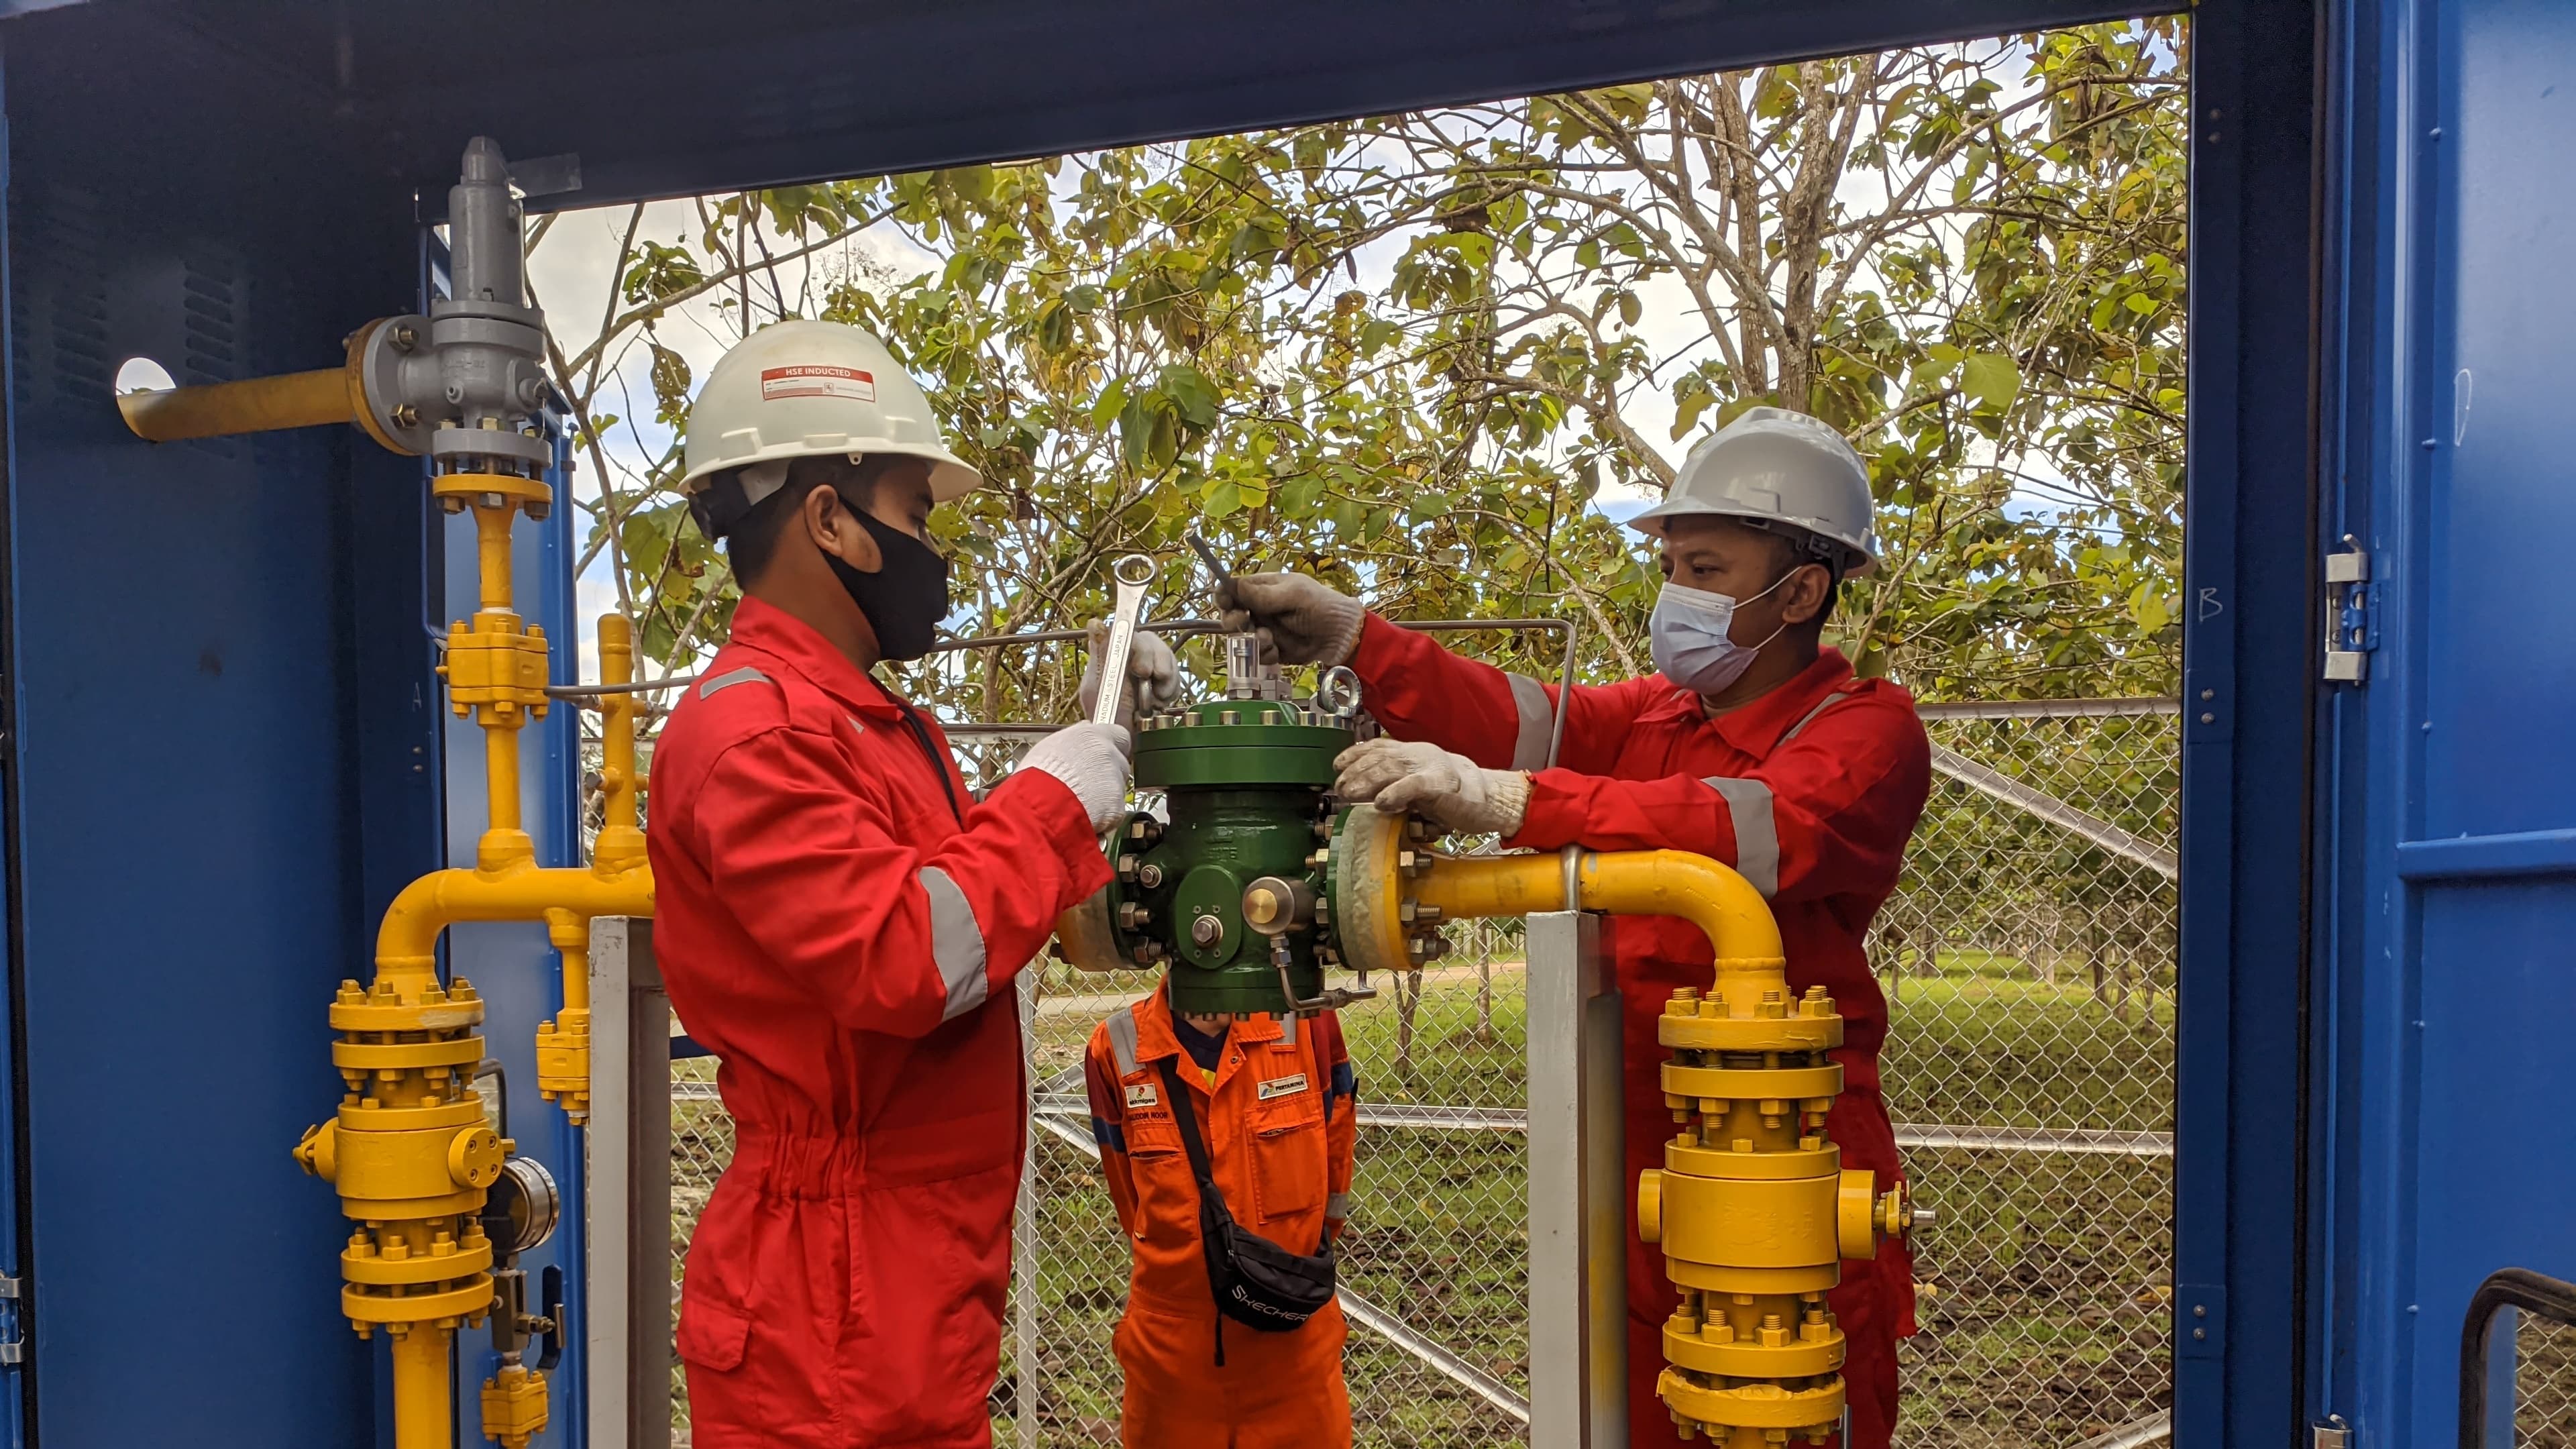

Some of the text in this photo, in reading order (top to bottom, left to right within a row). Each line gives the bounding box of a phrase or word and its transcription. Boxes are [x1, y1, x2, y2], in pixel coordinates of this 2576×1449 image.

[805, 368, 851, 377] INDUCTED
[2199, 588, 2222, 623] B
[1099, 635, 1124, 724] NADIUM STEEL JAPAN
[1275, 1080, 1305, 1091] PERTAMINA
